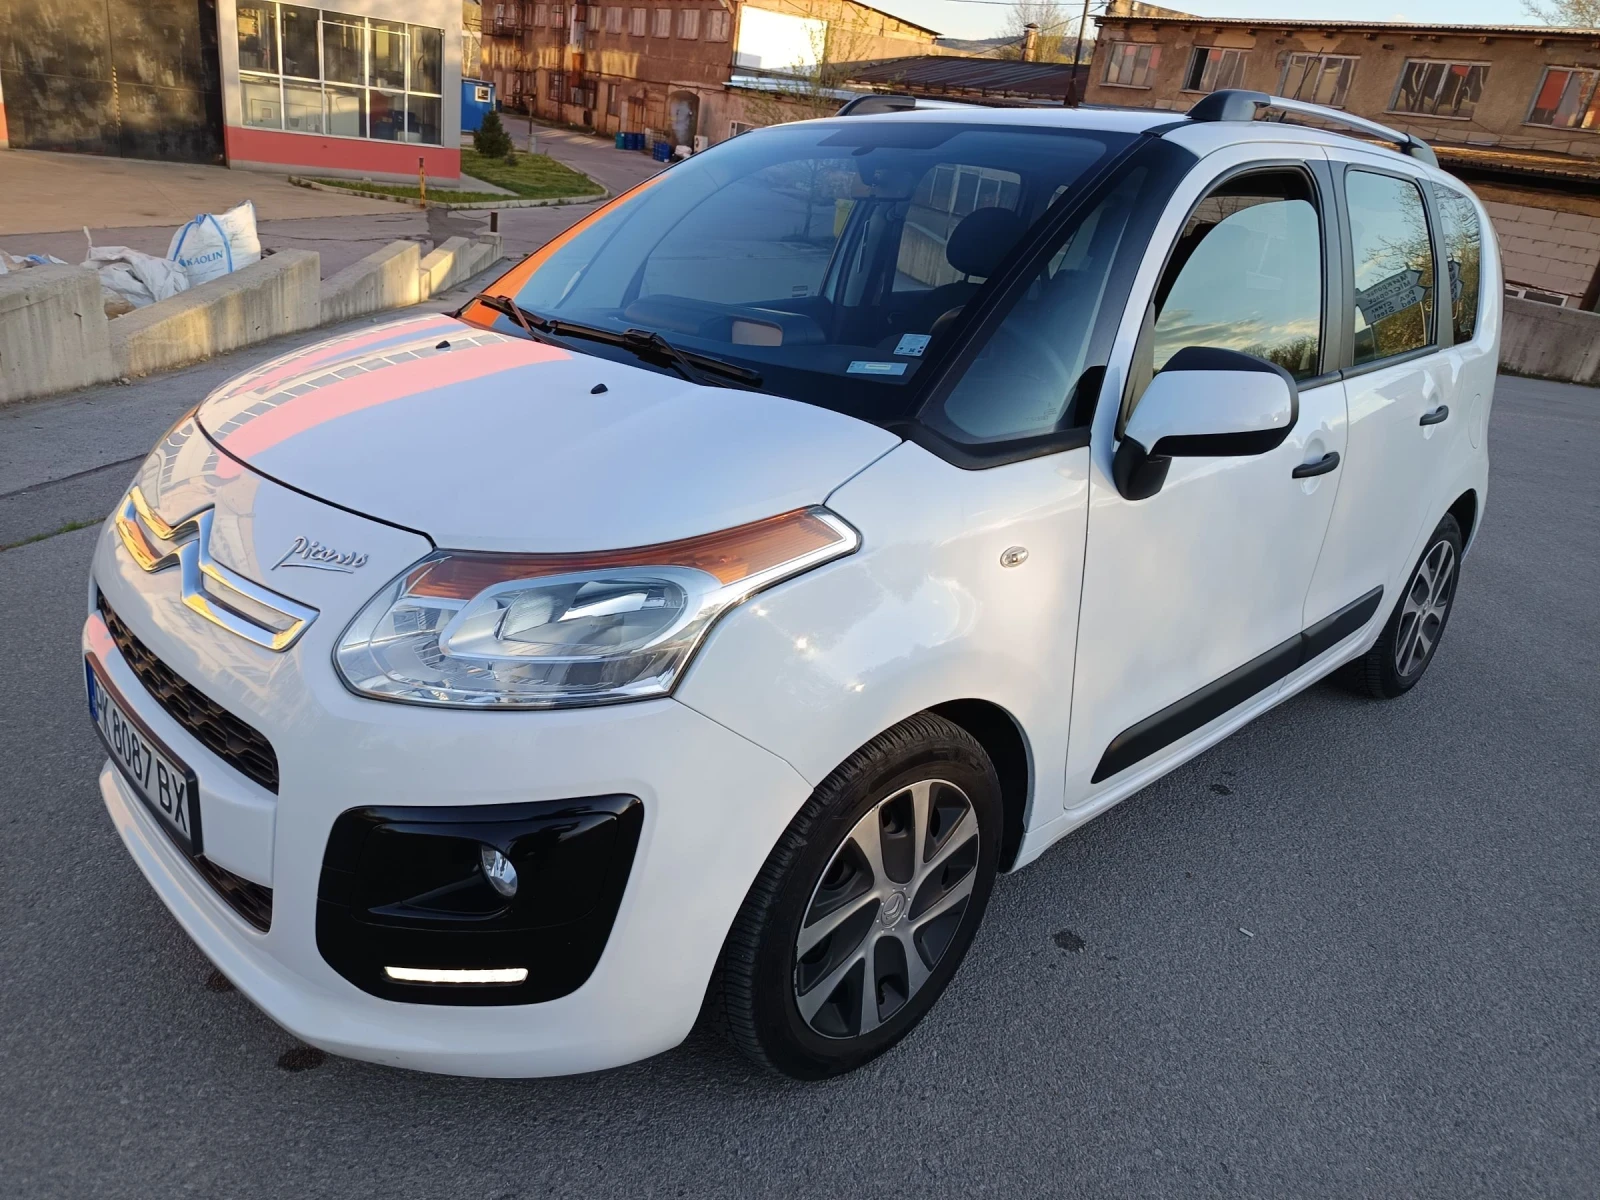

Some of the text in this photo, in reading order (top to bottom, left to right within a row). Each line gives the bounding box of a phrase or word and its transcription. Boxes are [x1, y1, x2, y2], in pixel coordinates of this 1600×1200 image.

[187, 251, 223, 266] KAOLIN
[113, 708, 152, 790] 8087
[156, 758, 188, 832] BX
